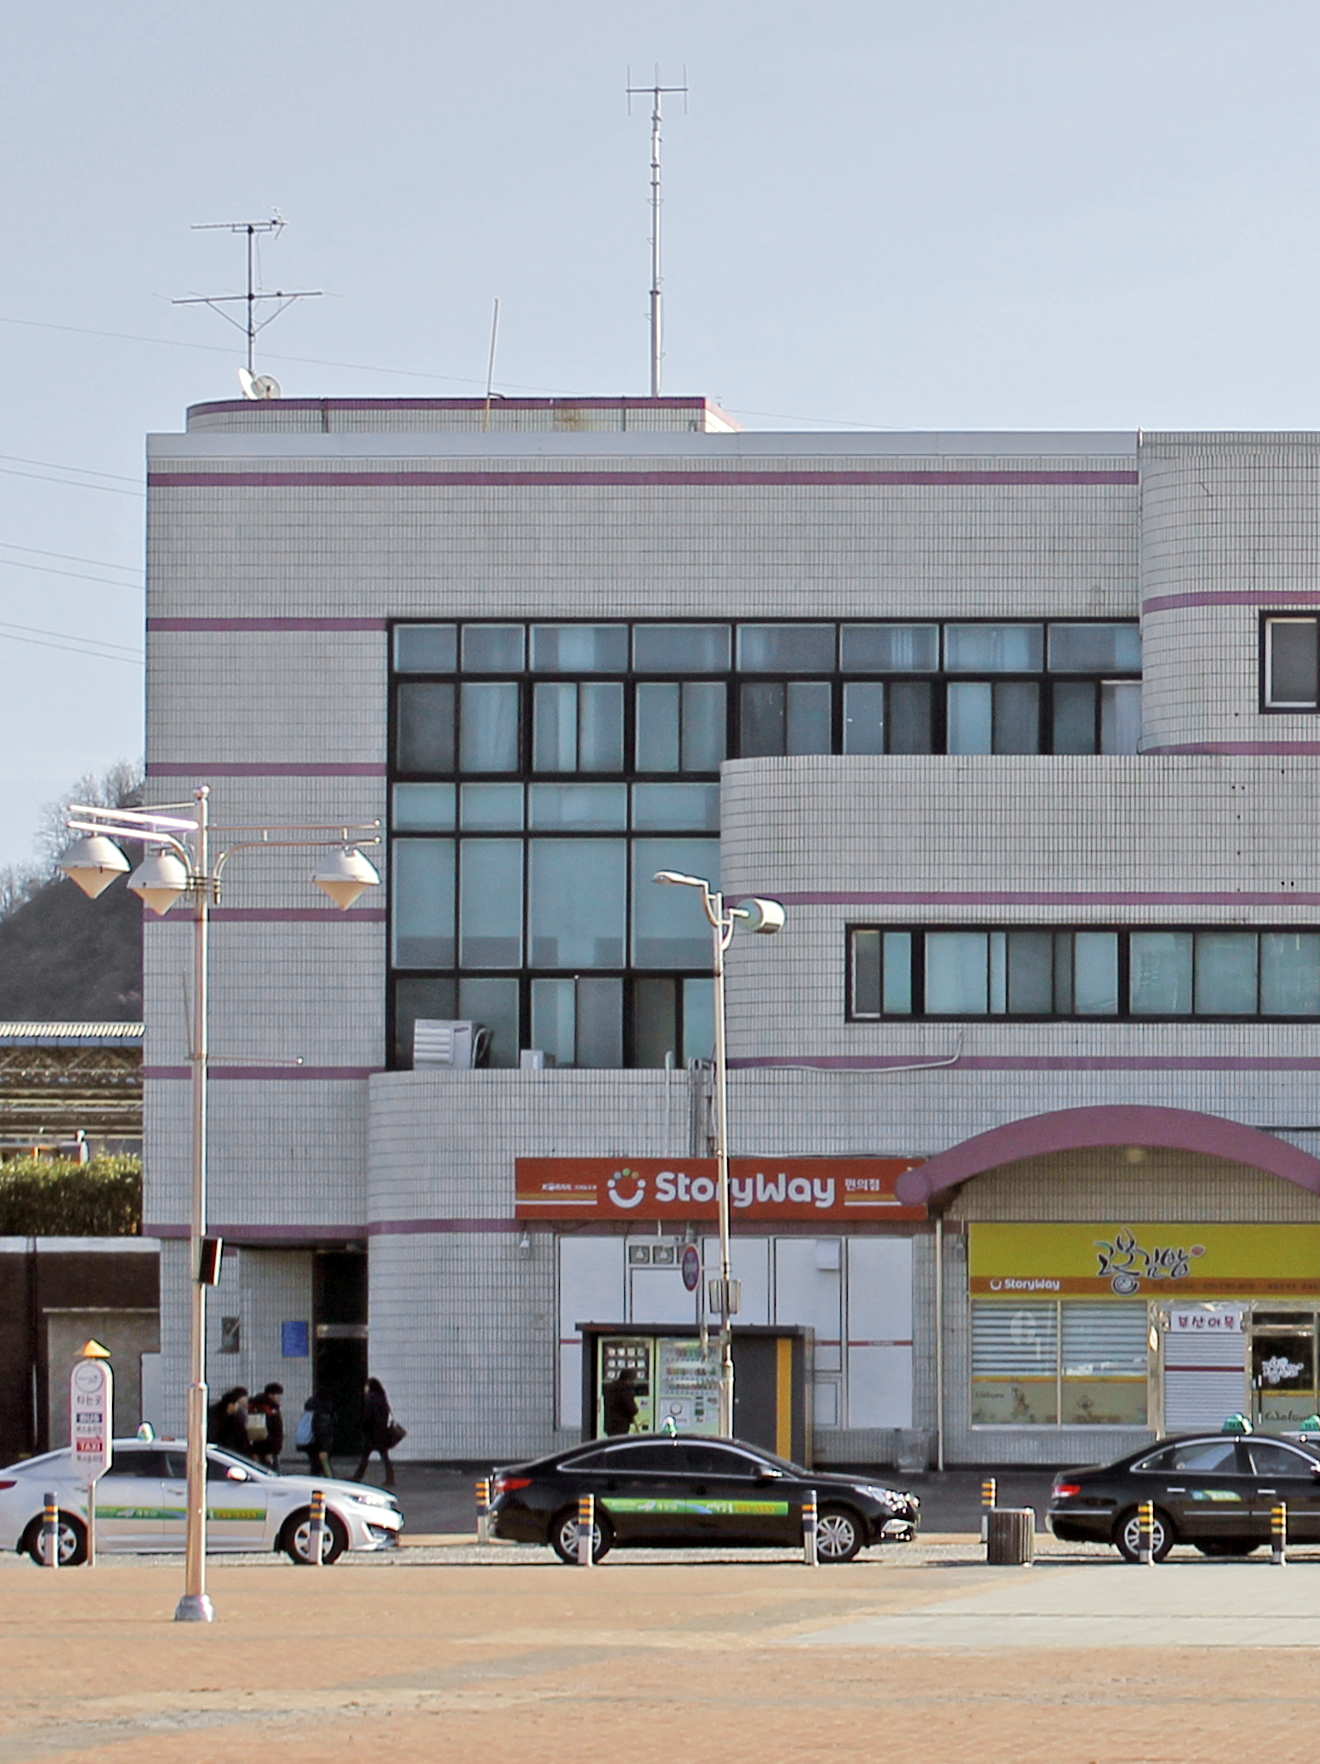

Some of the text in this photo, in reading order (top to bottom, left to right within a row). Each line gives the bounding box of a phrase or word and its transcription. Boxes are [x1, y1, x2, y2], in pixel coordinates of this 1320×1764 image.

[844, 1177, 881, 1191] 편의점
[1004, 1277, 1061, 1292] StoryWay
[81, 1442, 100, 1451] TAXI
